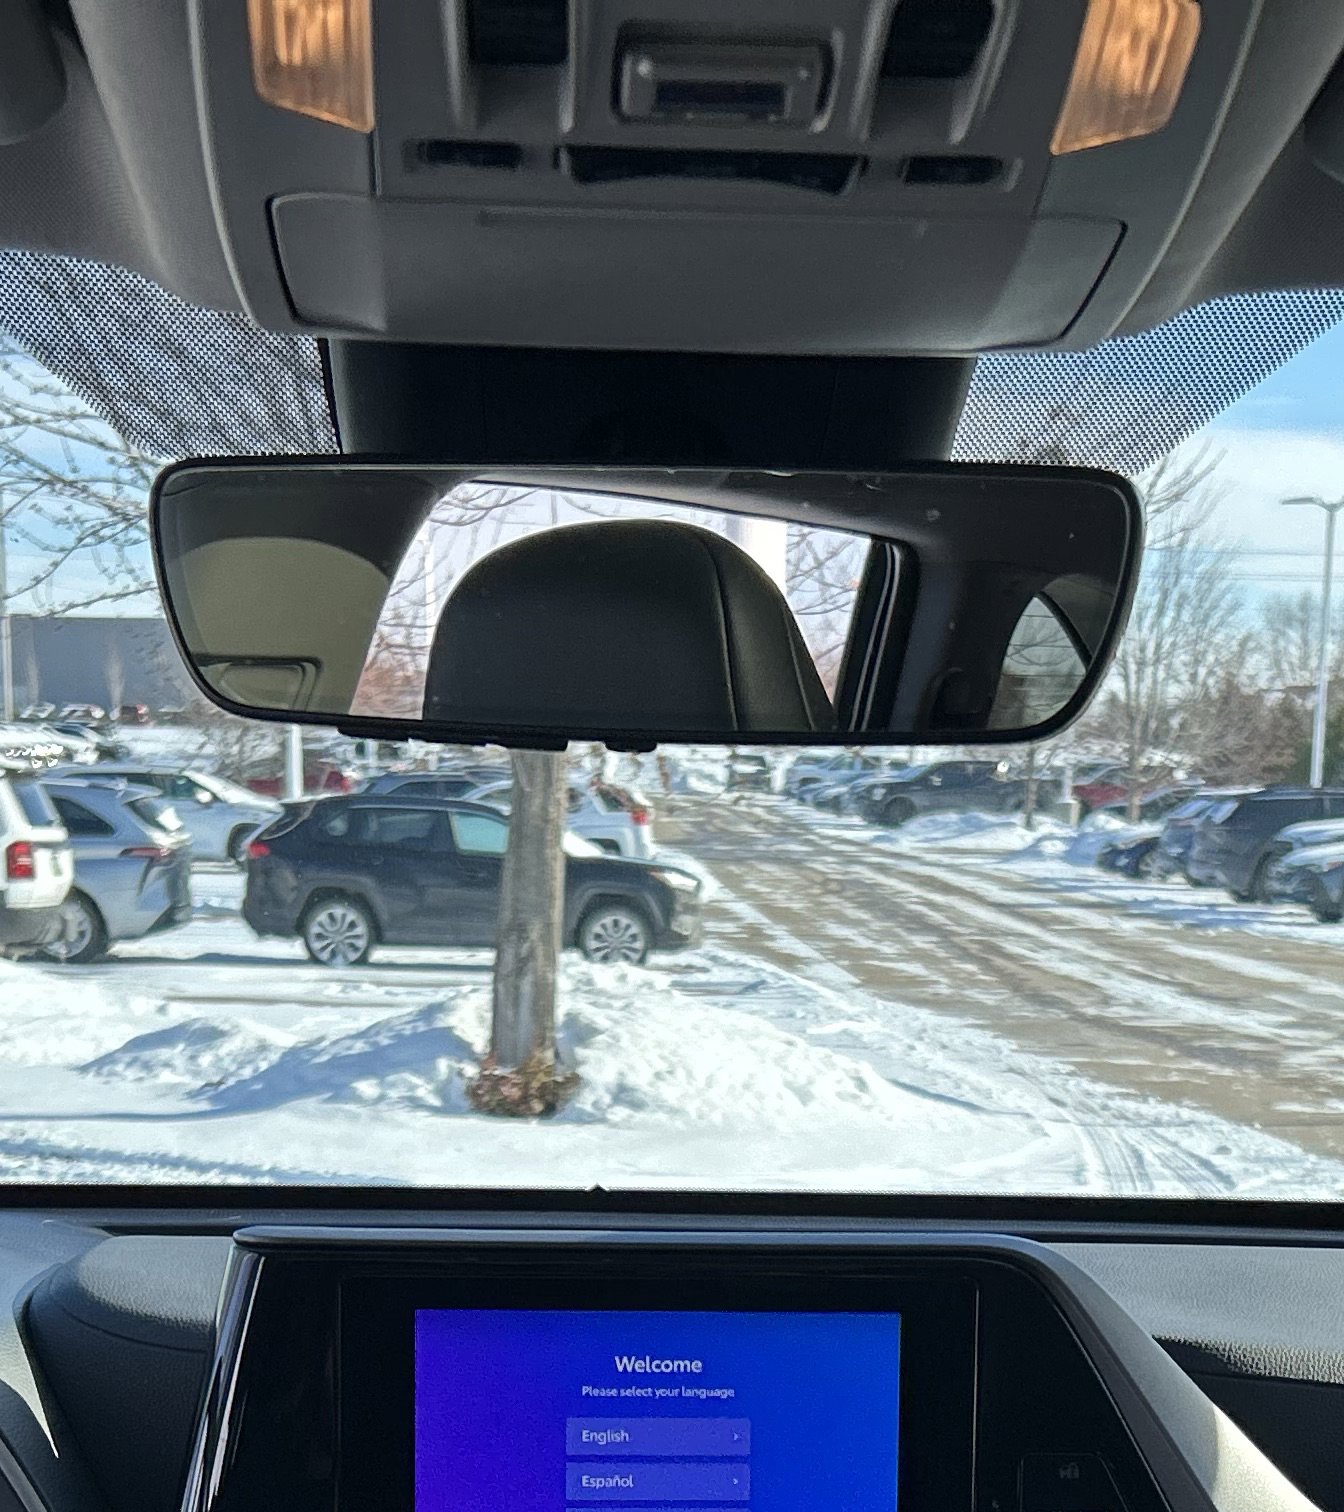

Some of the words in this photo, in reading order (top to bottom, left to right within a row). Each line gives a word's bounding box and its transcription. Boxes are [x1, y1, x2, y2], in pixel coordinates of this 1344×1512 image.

[614, 1355, 703, 1374] Welcome
[581, 1385, 618, 1398] Please
[619, 1385, 653, 1398] select
[654, 1387, 680, 1400] your
[681, 1385, 735, 1400] language
[581, 1429, 630, 1446] English
[581, 1474, 634, 1490] Español
